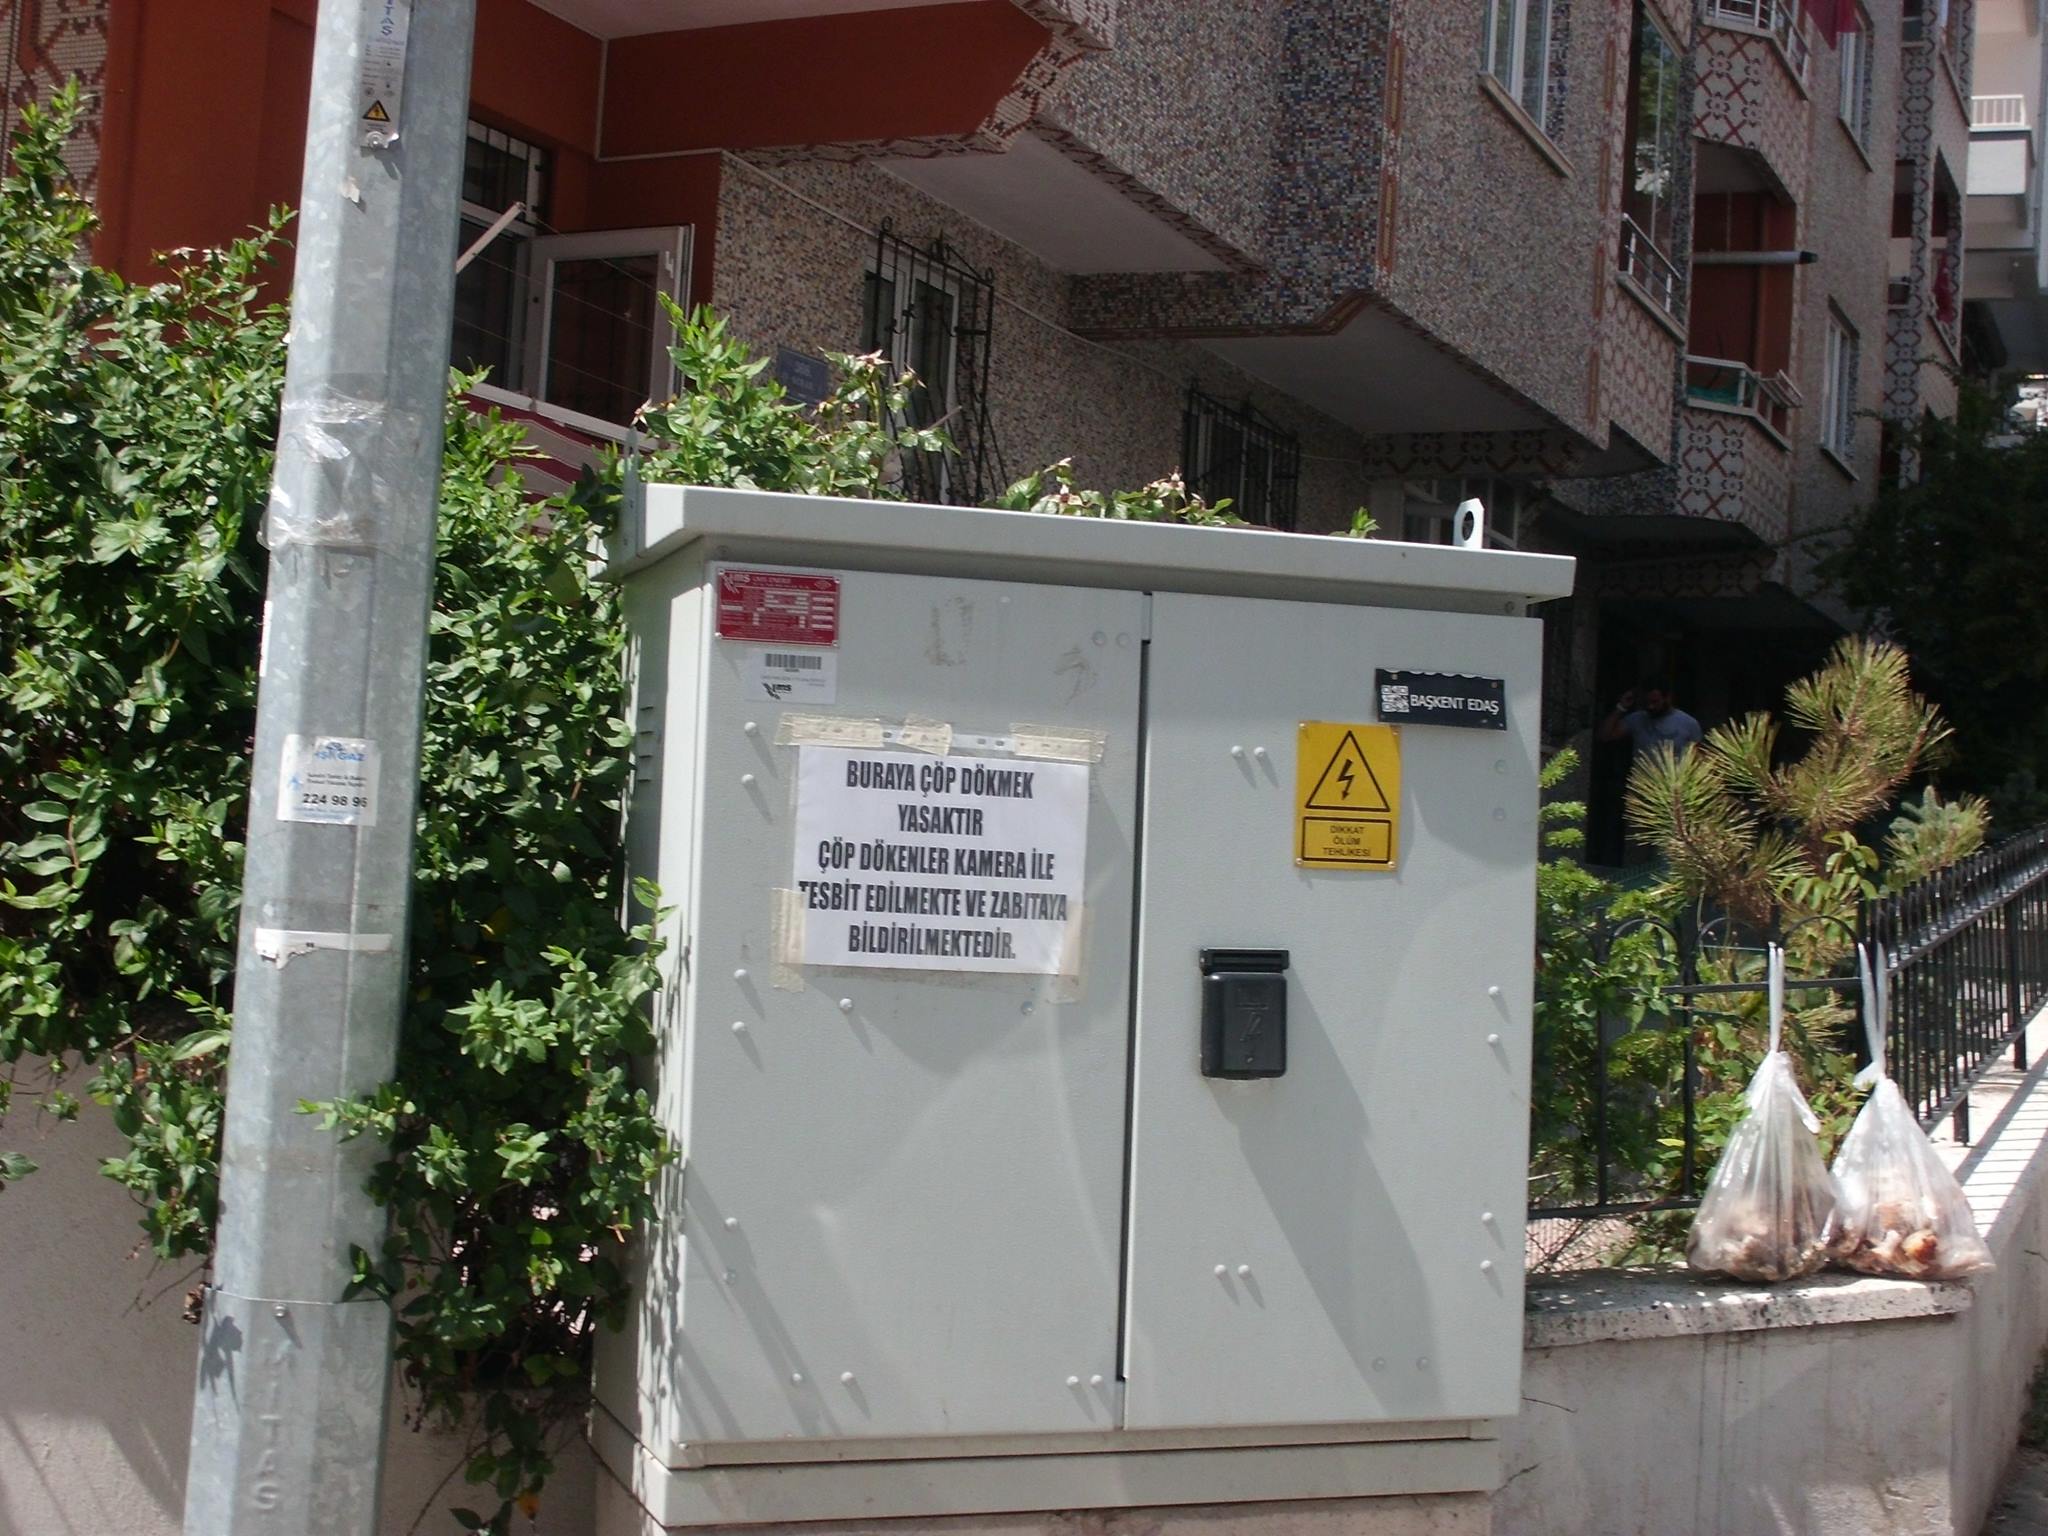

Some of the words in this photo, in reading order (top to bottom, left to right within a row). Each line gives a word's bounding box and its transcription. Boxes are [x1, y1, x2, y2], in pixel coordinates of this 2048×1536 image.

[1410, 694, 1465, 710] BAŞKENT
[1467, 698, 1500, 715] EDAŞ
[302, 793, 327, 805] 224
[847, 760, 916, 791] BURAYA
[920, 761, 956, 798] ÇÖP
[960, 764, 1035, 799] DÖKMEK
[898, 804, 983, 836] YASAKTIR
[819, 836, 855, 874] ÇÖP
[860, 839, 949, 875] DÖKENLER
[954, 848, 1027, 879] KAMERA
[1030, 848, 1055, 880] İLE
[865, 881, 961, 916] EDİLMEKTE
[966, 889, 986, 917] VE
[990, 890, 1068, 921] ZABITAYA
[848, 920, 1016, 959] BİLDİRİLMEKTEDİR.
